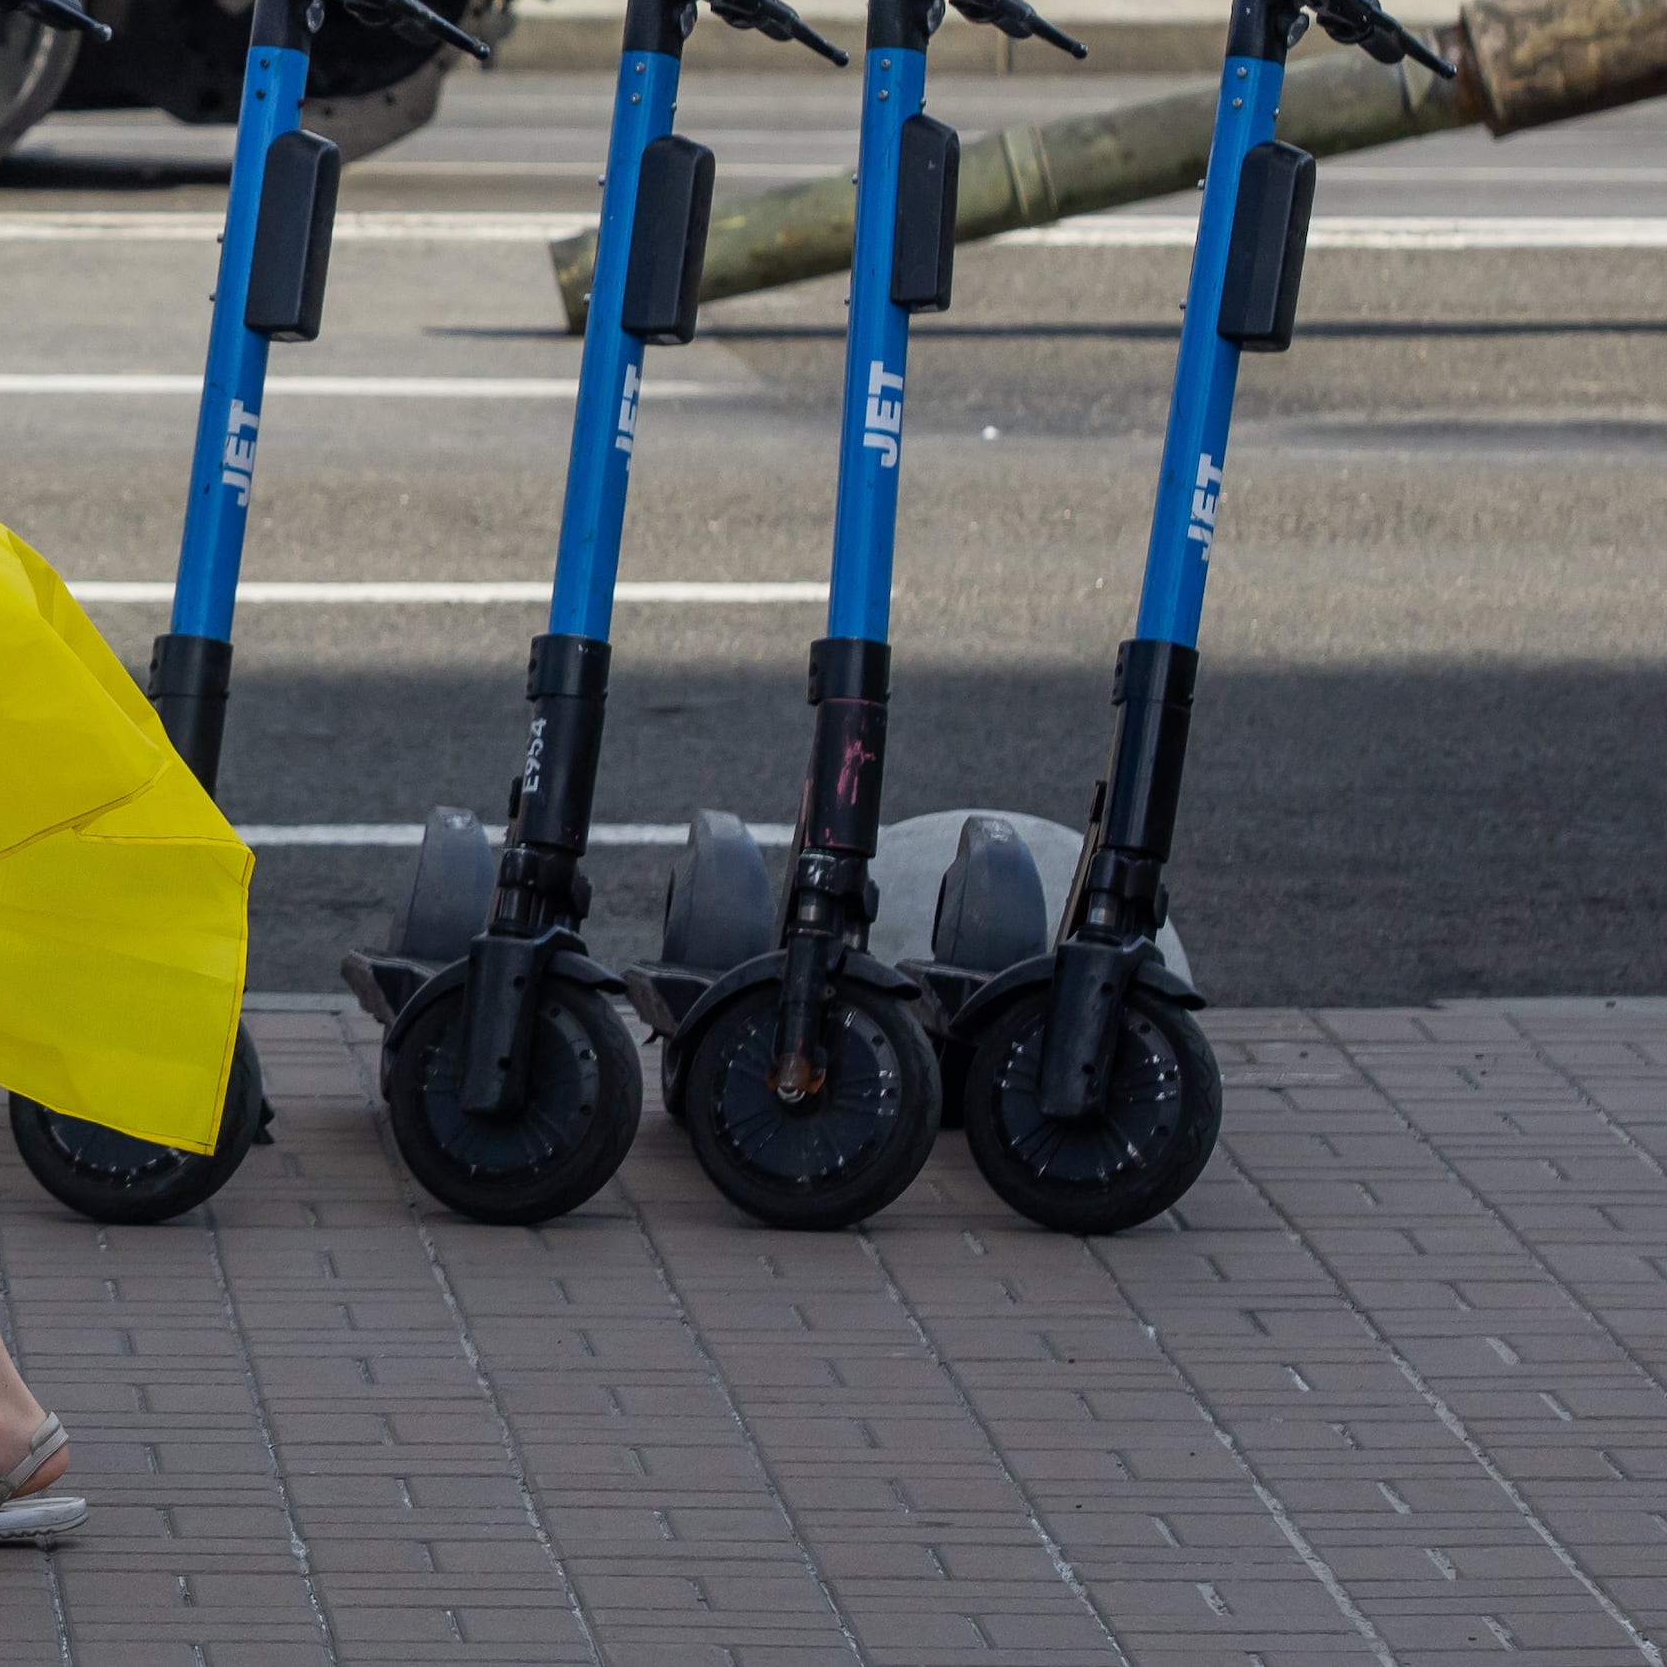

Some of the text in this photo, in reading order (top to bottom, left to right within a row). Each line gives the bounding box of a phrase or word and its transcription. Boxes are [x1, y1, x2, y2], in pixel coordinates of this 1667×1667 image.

[222, 398, 259, 508] JET
[863, 360, 903, 467] JET
[1187, 452, 1223, 562] JET
[522, 717, 548, 794] E954
